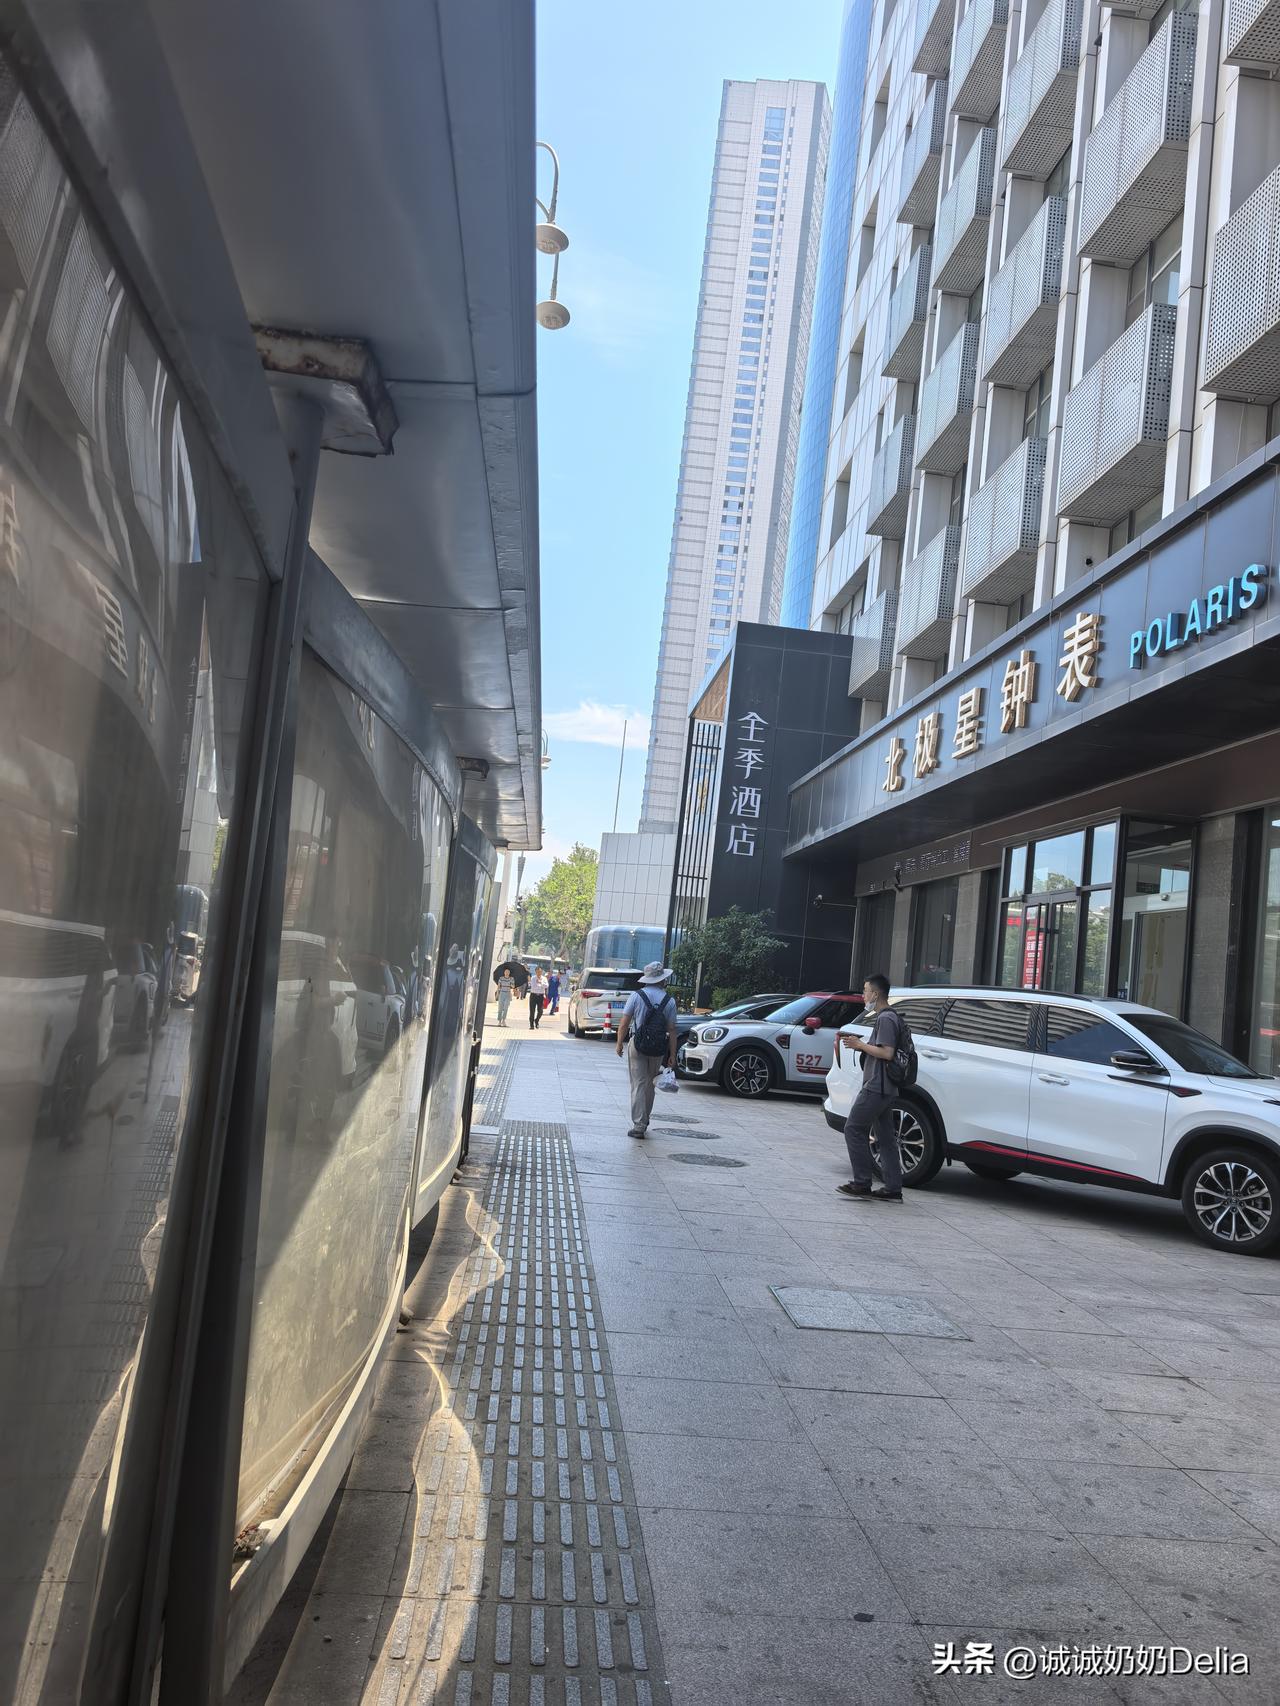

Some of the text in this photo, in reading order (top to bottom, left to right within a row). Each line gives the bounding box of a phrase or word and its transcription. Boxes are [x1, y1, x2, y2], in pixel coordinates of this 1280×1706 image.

[882, 563, 1268, 792] 北极星钟表 POLARIS
[725, 711, 769, 857] 全季酒店
[796, 1053, 823, 1067] 527
